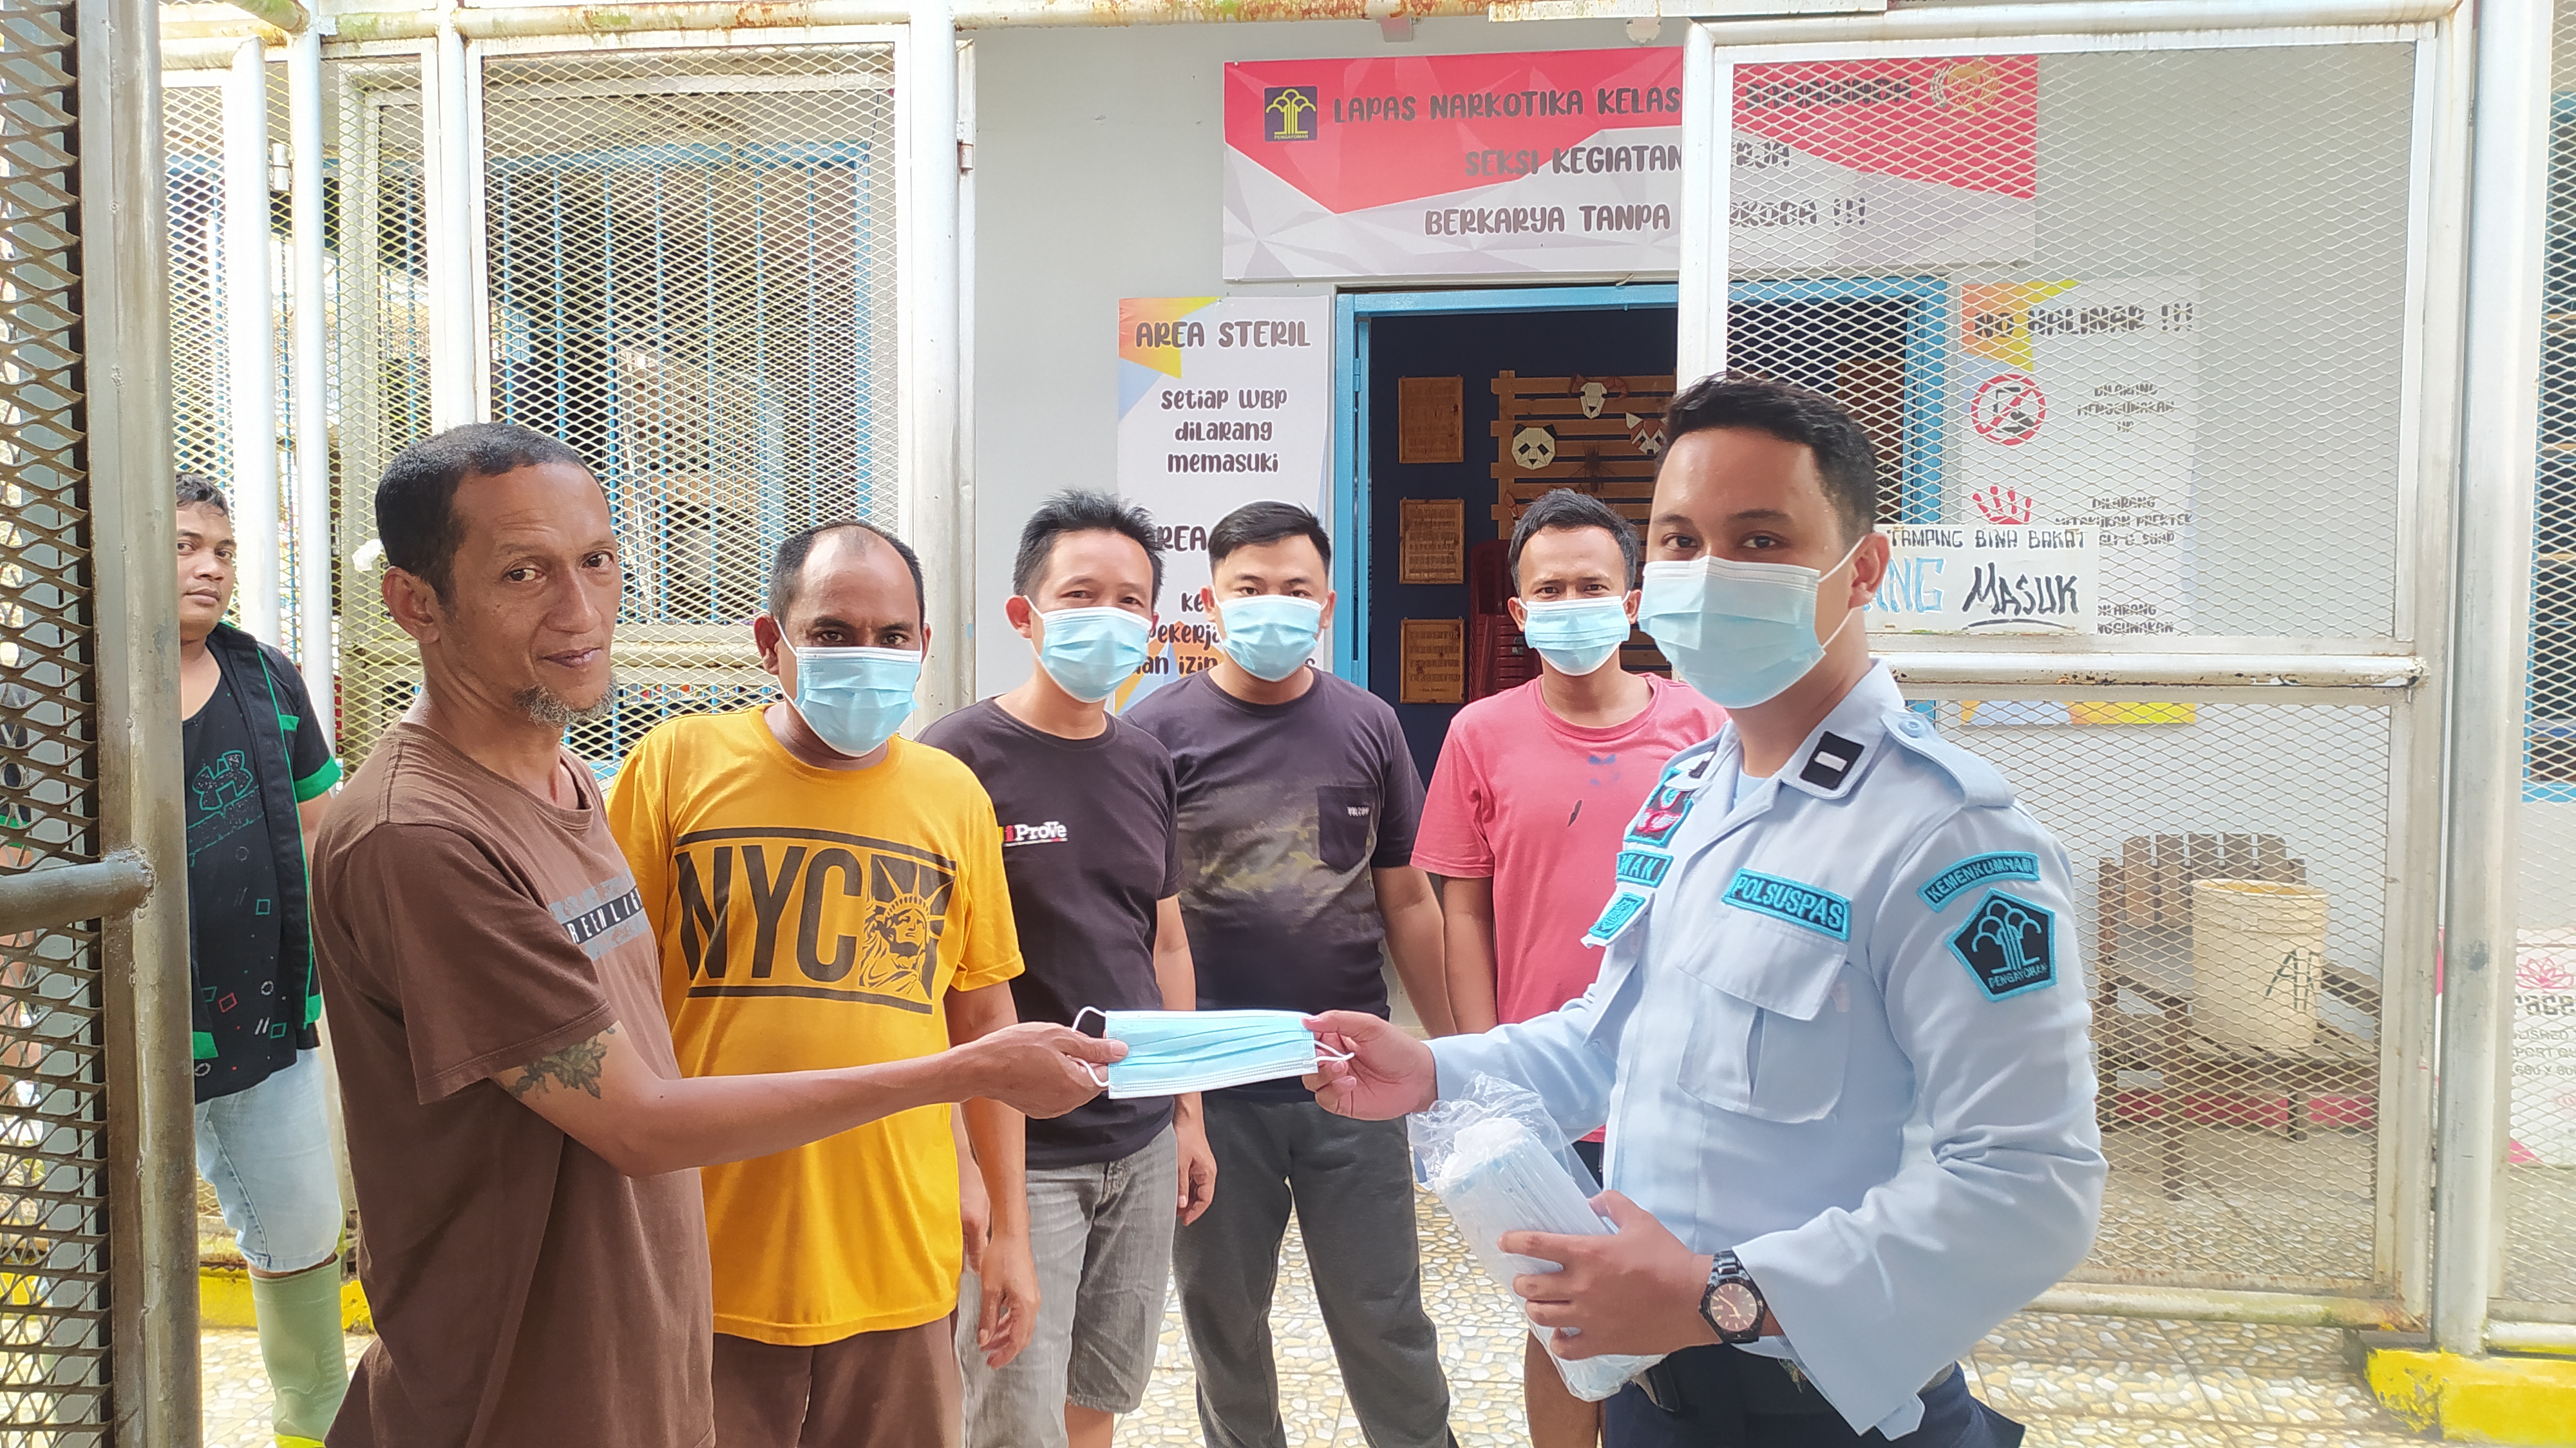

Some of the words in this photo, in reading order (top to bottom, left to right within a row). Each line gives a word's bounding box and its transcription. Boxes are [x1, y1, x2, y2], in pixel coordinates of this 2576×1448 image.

[1334, 96, 1417, 123] LAPAS
[1430, 88, 1584, 120] NARKOTIKA
[1598, 86, 1681, 116] KELAS
[1465, 149, 1539, 176] SEKSI
[1553, 144, 1682, 174] KEGIATAN
[1425, 205, 1566, 236] BERKARYA
[1579, 204, 1671, 233] TANPA
[1136, 321, 1205, 348] AREA
[1218, 321, 1311, 347] STERIL
[1975, 312, 2015, 339] NO
[1239, 389, 1287, 409] WBP
[1156, 525, 1207, 551] REA
[1975, 529, 2018, 548] BINA
[675, 844, 863, 983] NYC
[1732, 876, 1844, 929] POLSUSPAS
[567, 908, 607, 944] REEN
